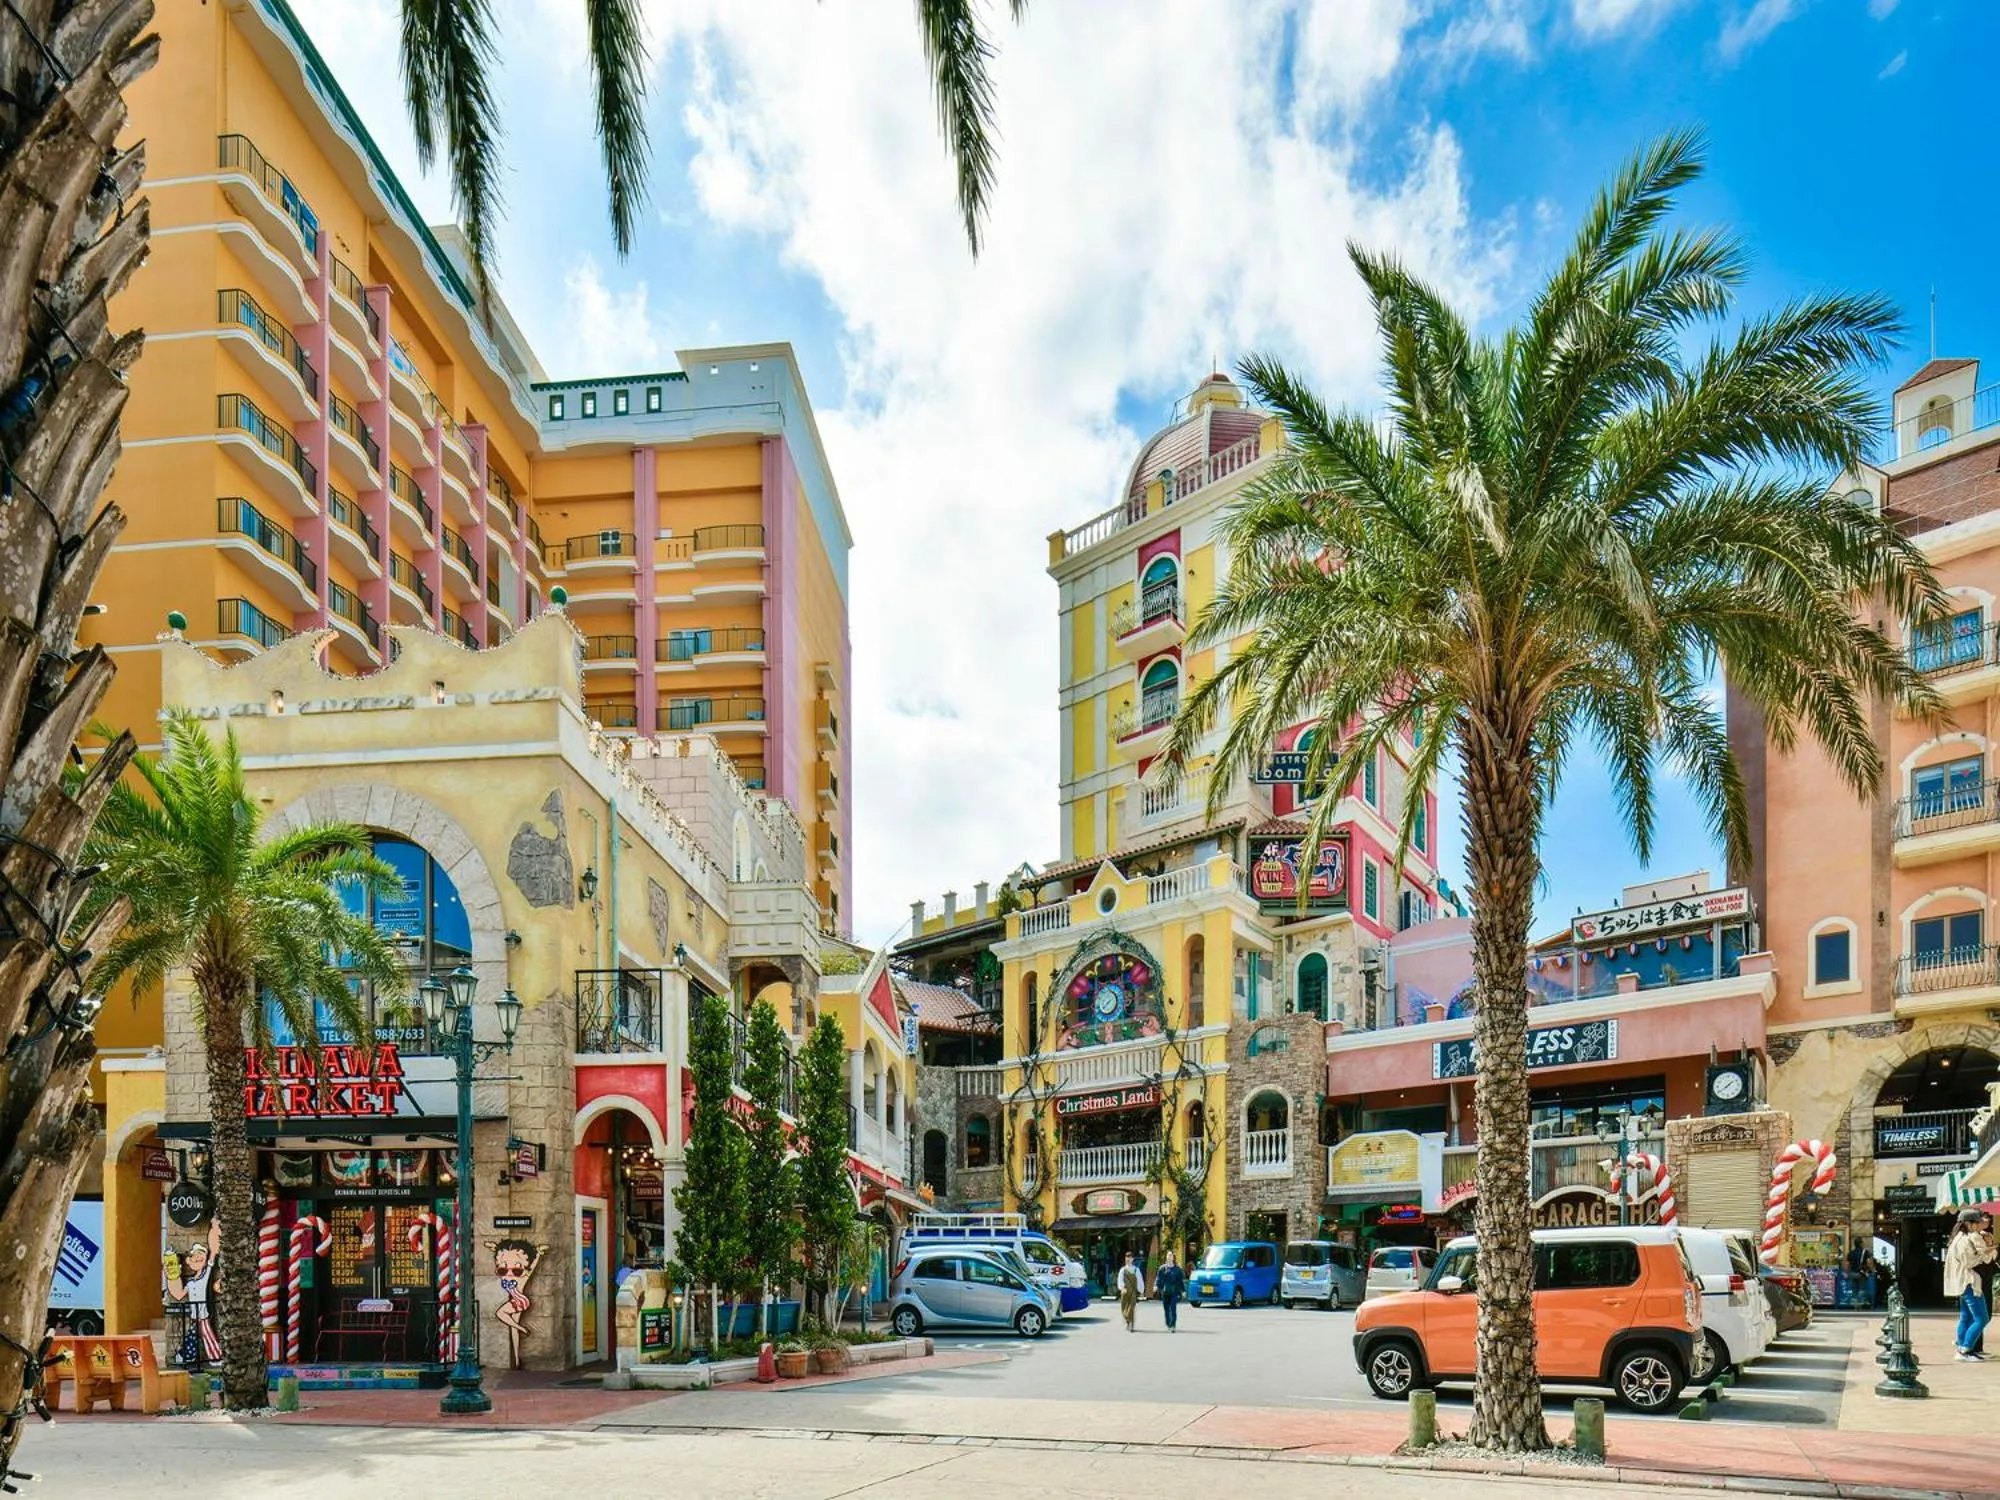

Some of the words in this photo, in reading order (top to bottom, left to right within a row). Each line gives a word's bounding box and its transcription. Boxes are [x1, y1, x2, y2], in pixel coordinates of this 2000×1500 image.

[1266, 755, 1309, 764] ISTRO
[1258, 871, 1285, 882] WINE
[1704, 893, 1744, 907] OKINAWAN
[1726, 902, 1742, 911] FOOD
[1598, 902, 1704, 937] ちゅらはま食堂
[322, 1030, 341, 1042] TEL
[243, 1045, 405, 1079] KINAWA
[1528, 1054, 1565, 1067] LATE
[243, 1083, 400, 1117] ARKET
[1056, 1094, 1119, 1114] Christmas
[1121, 1087, 1153, 1105] Land
[1884, 1130, 1938, 1143] TIMELESS
[1531, 1199, 1620, 1228] GARAGE
[1630, 1201, 1661, 1225] HO
[64, 1234, 92, 1260] offee
